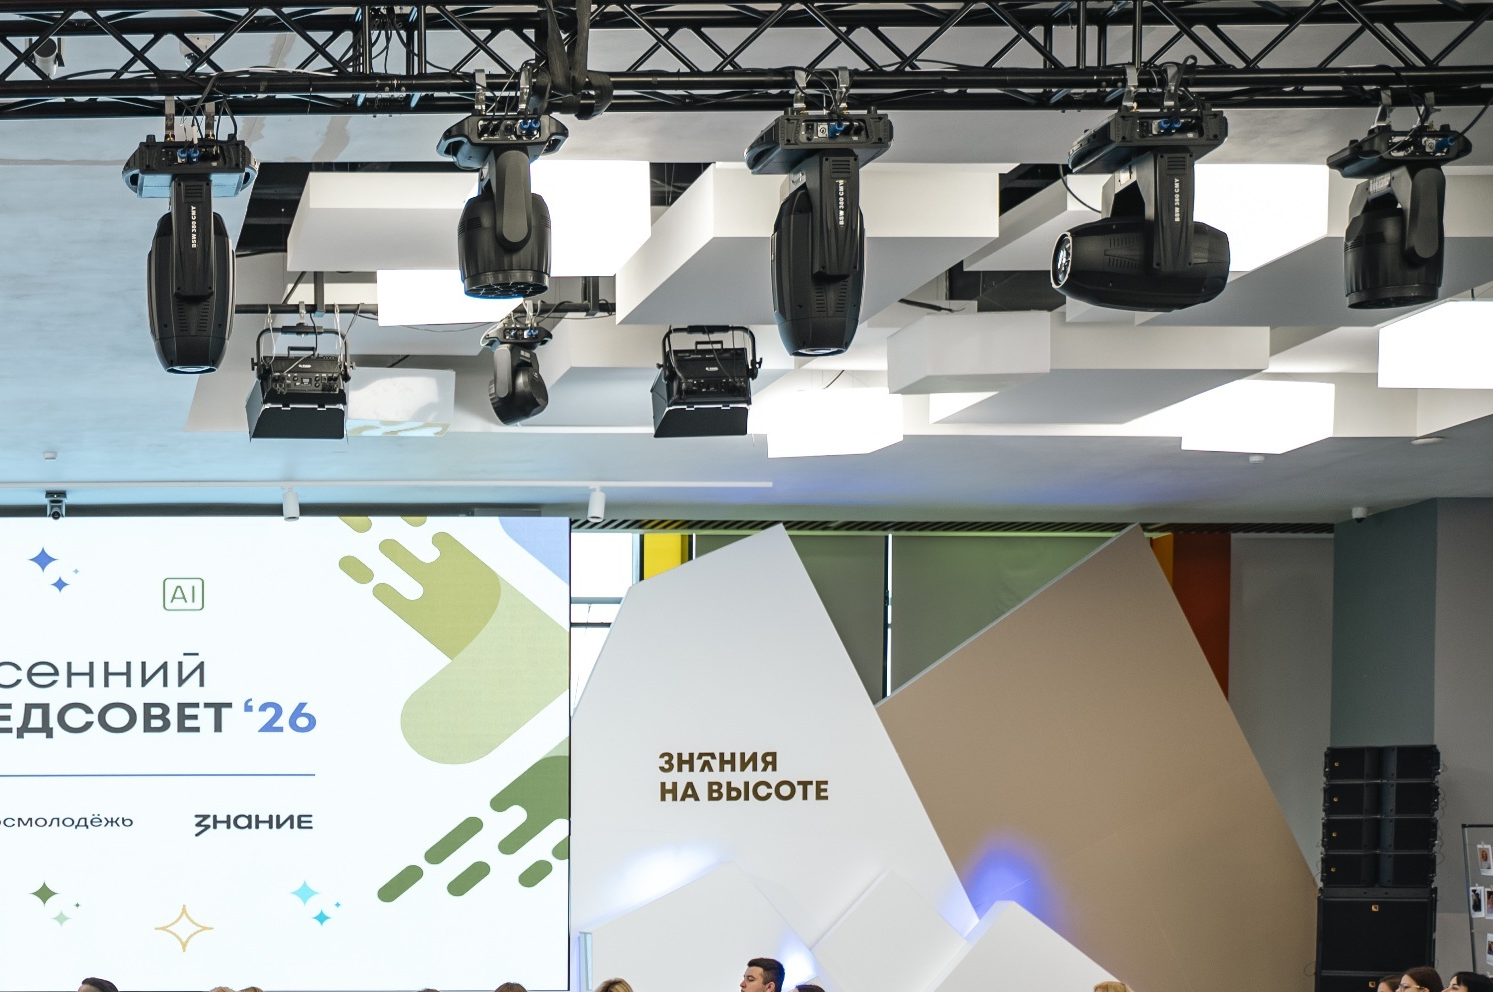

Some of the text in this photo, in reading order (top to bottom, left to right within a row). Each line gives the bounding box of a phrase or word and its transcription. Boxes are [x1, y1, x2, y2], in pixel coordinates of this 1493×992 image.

[658, 751, 778, 774] ЗНАНИЯ
[659, 779, 829, 802] НА ВЫСОТЕ
